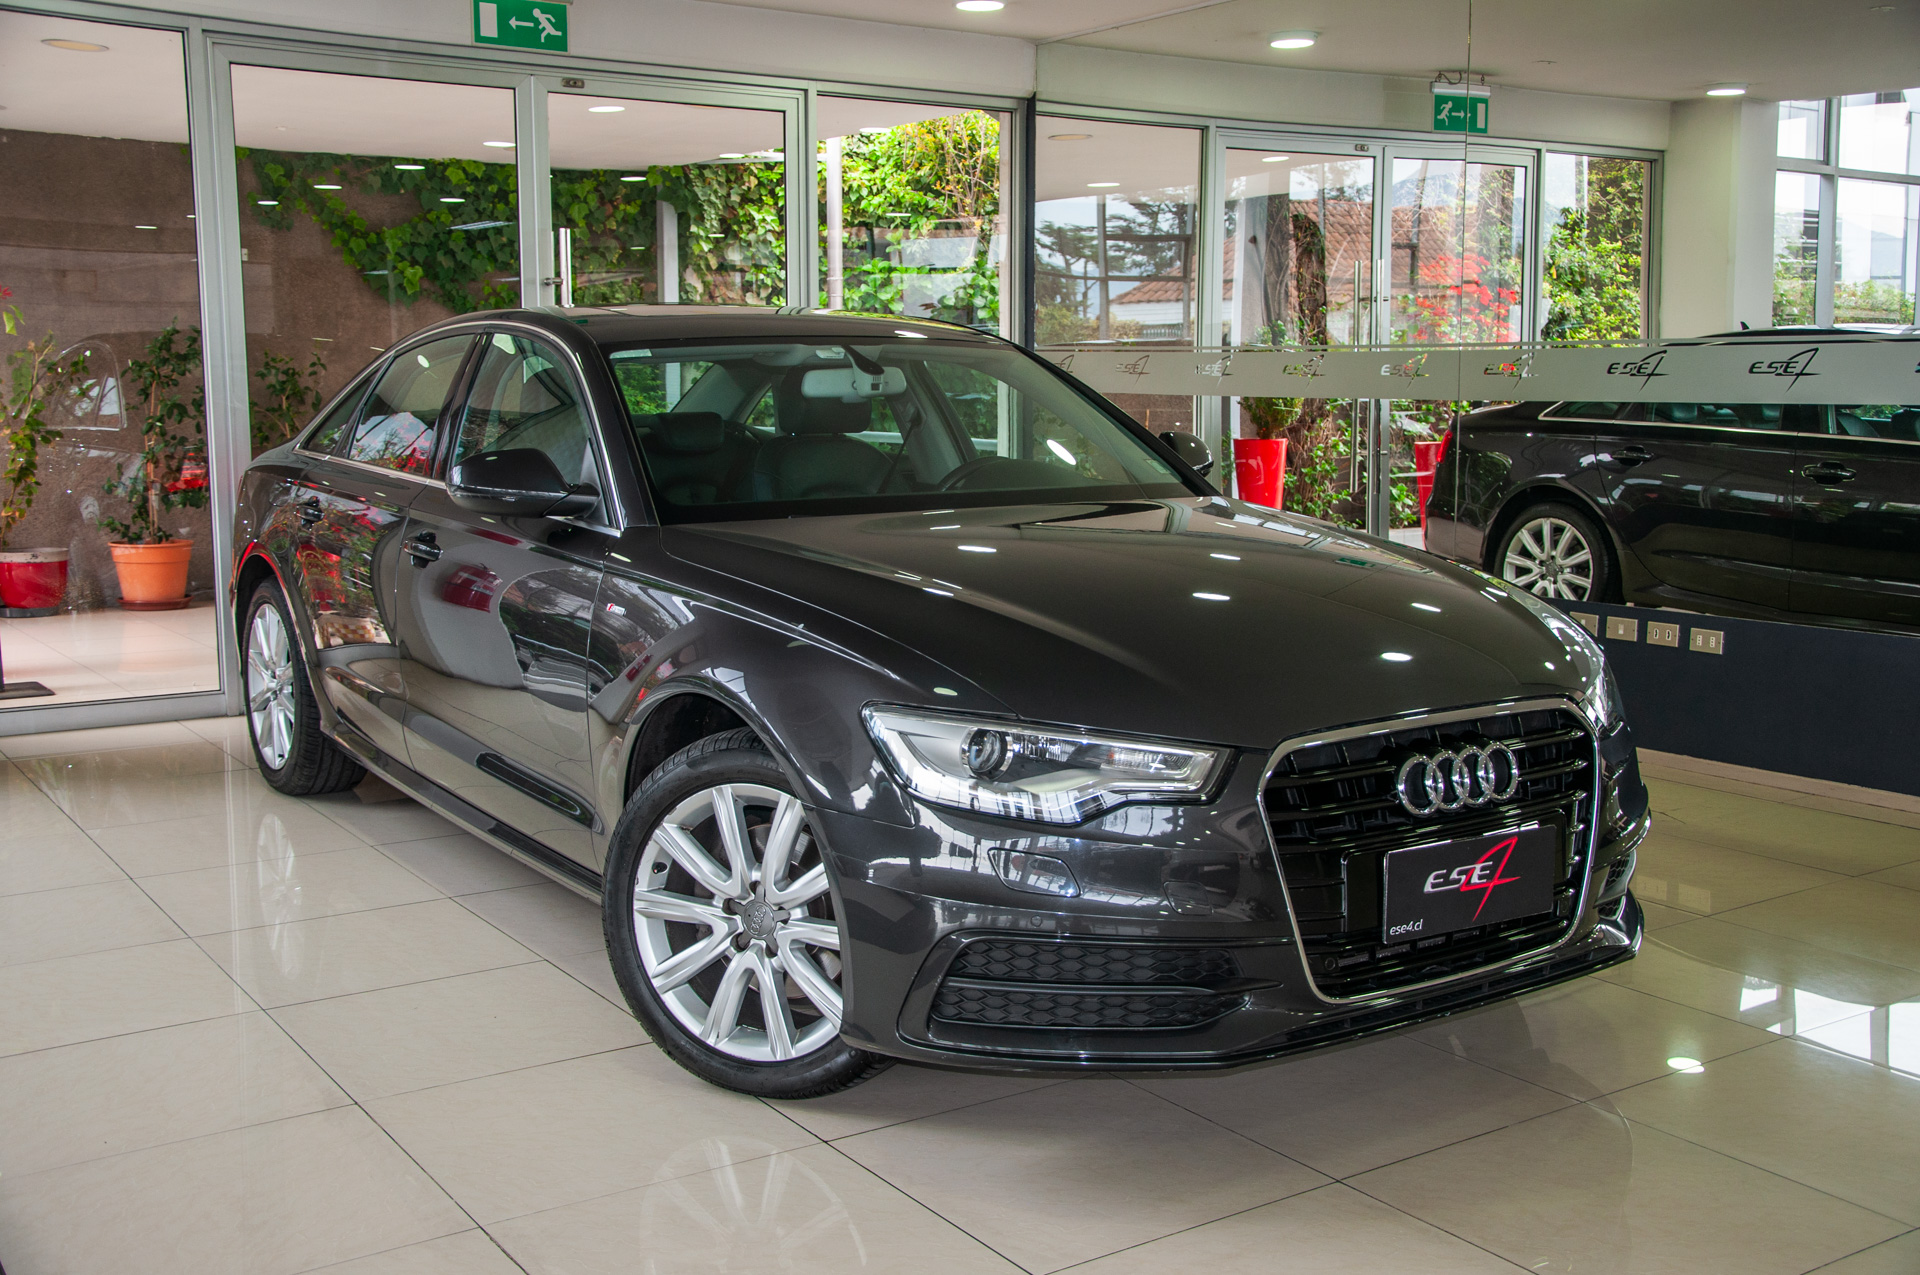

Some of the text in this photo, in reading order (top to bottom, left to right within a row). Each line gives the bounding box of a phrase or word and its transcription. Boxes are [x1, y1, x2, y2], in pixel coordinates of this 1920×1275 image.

[1606, 349, 1670, 393] ESE4
[1748, 347, 1821, 394] ESE4
[1423, 836, 1521, 922] ESE4
[1390, 919, 1423, 936] ese4.cl
